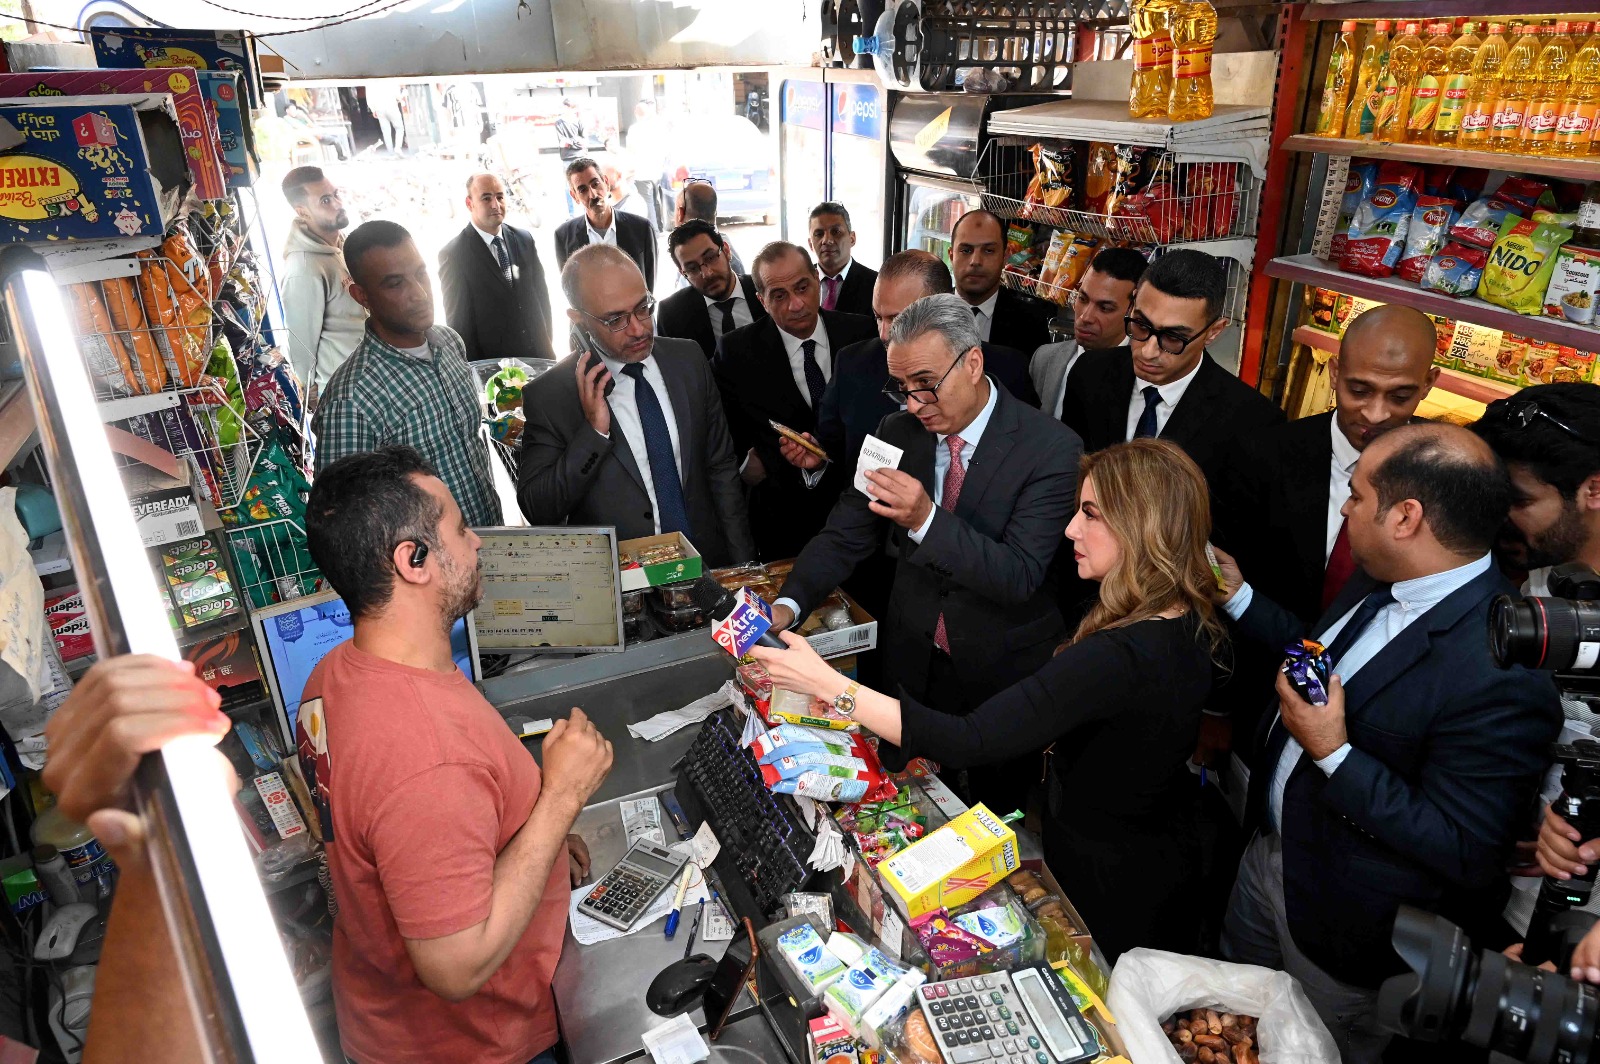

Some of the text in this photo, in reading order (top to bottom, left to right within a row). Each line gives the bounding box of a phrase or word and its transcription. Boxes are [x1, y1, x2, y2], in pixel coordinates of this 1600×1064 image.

[851, 99, 878, 121] pepsi
[0, 166, 60, 188] EXTRE
[104, 189, 133, 198] 2025
[1490, 245, 1542, 277] NIDO
[1452, 346, 1467, 358] 220
[134, 495, 191, 518] EVEREADY
[174, 559, 218, 577] Clorets
[191, 598, 234, 616] Clorets
[737, 624, 758, 648] news
[973, 809, 1006, 838] MEELOX
[1003, 840, 1013, 872] MEELOX
